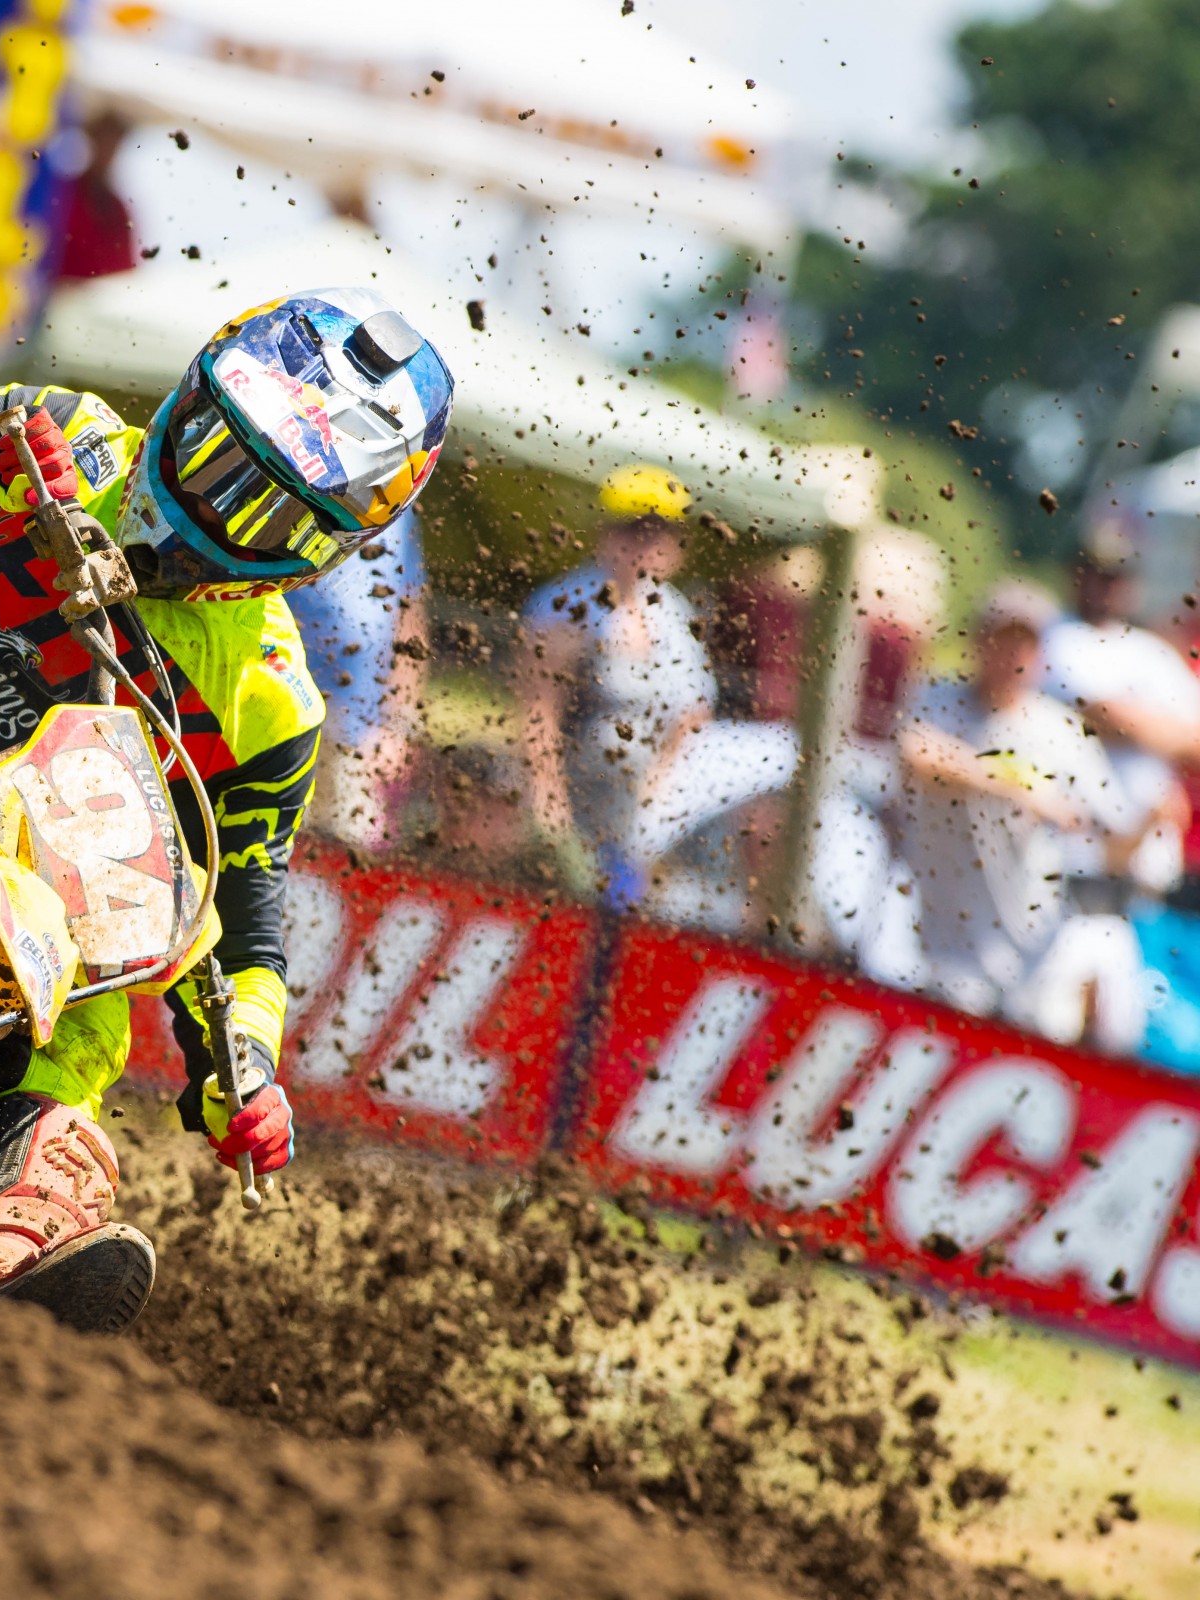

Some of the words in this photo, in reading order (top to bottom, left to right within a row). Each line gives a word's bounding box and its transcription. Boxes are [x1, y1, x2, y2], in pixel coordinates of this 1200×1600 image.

[276, 415, 328, 483] Bull
[136, 768, 175, 839] LUCAS
[12, 747, 175, 967] 94
